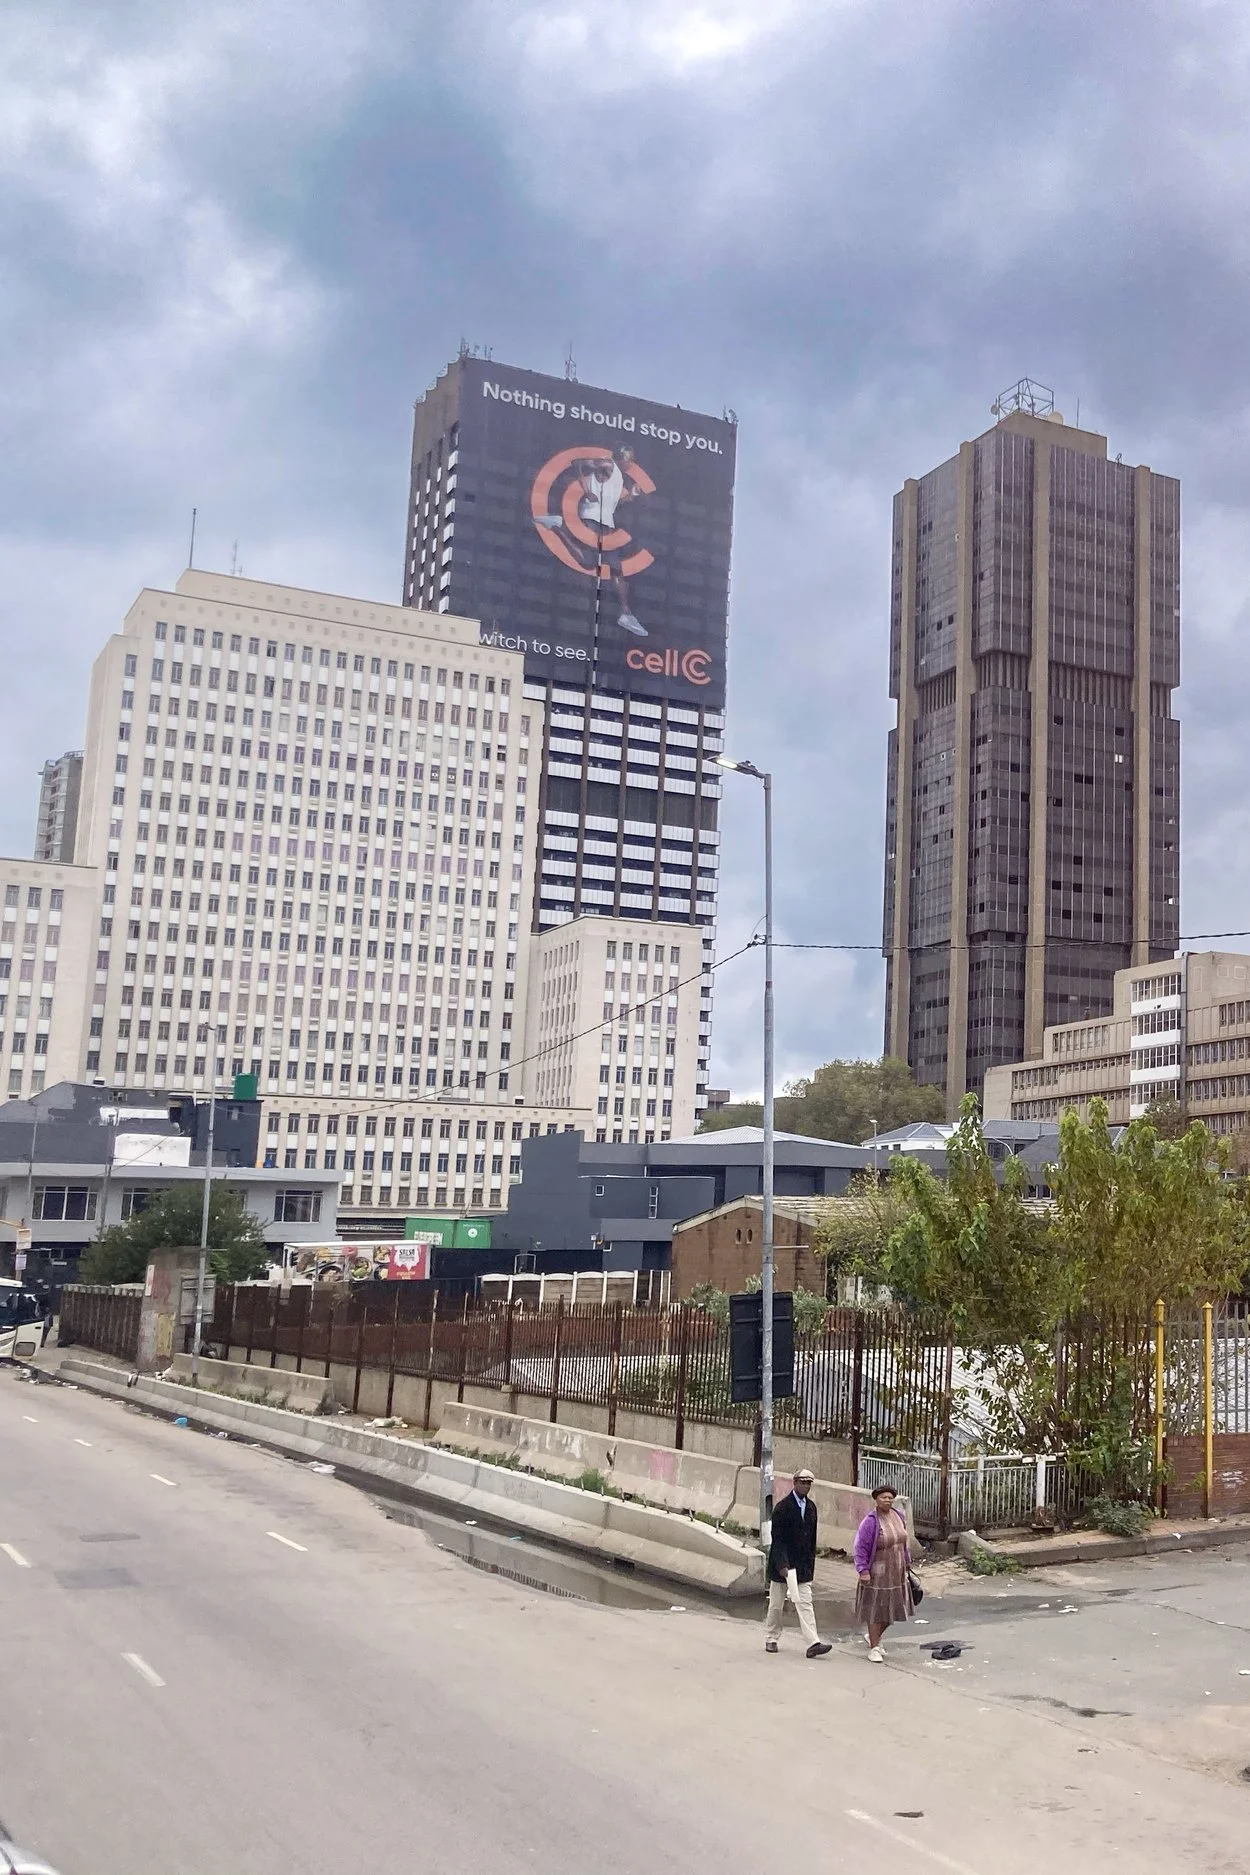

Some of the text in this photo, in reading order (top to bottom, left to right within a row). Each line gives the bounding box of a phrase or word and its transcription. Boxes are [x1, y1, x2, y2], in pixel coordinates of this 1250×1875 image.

[483, 381, 723, 455] Nothing should stop you.
[479, 631, 591, 662] witch to see.
